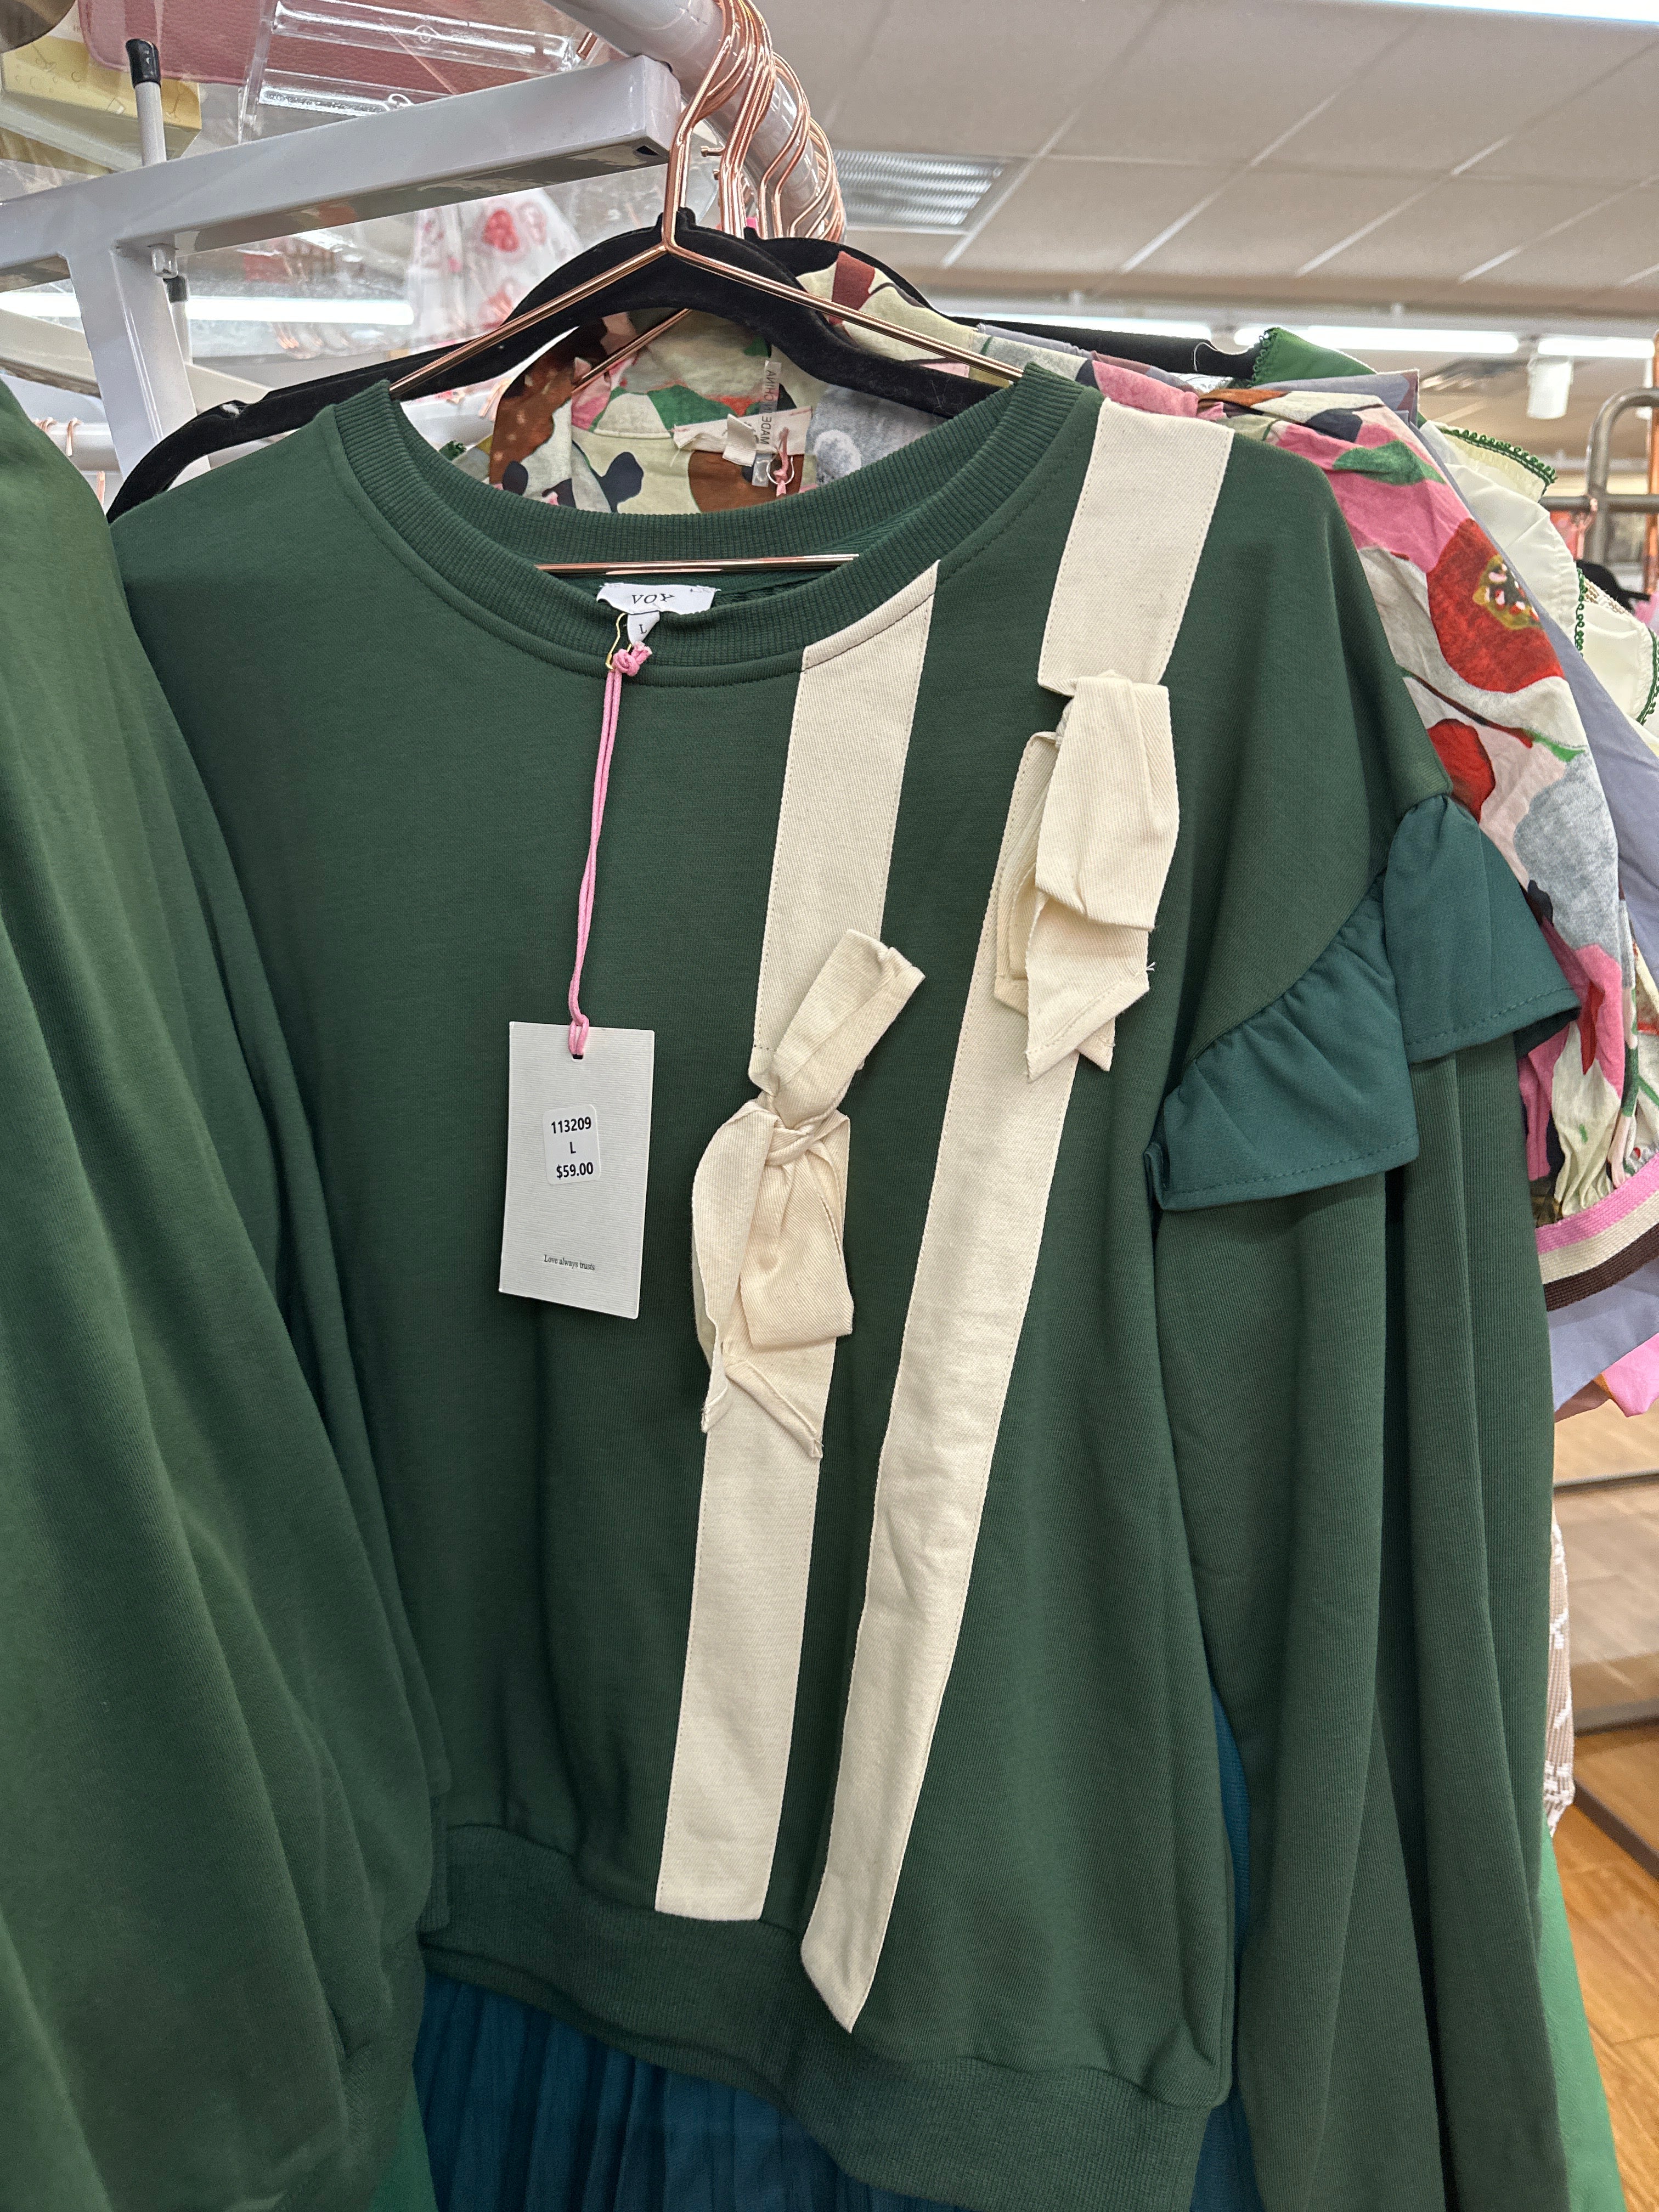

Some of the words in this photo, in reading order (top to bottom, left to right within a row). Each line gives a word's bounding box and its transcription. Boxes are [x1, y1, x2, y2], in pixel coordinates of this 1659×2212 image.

[632, 593, 675, 604] VOY
[639, 624, 647, 634] L
[551, 1116, 591, 1134] 113209
[569, 1141, 577, 1154] L
[556, 1161, 594, 1180] $59.00
[544, 1254, 558, 1264] Love
[559, 1257, 578, 1269] always
[579, 1262, 595, 1271] trusts
